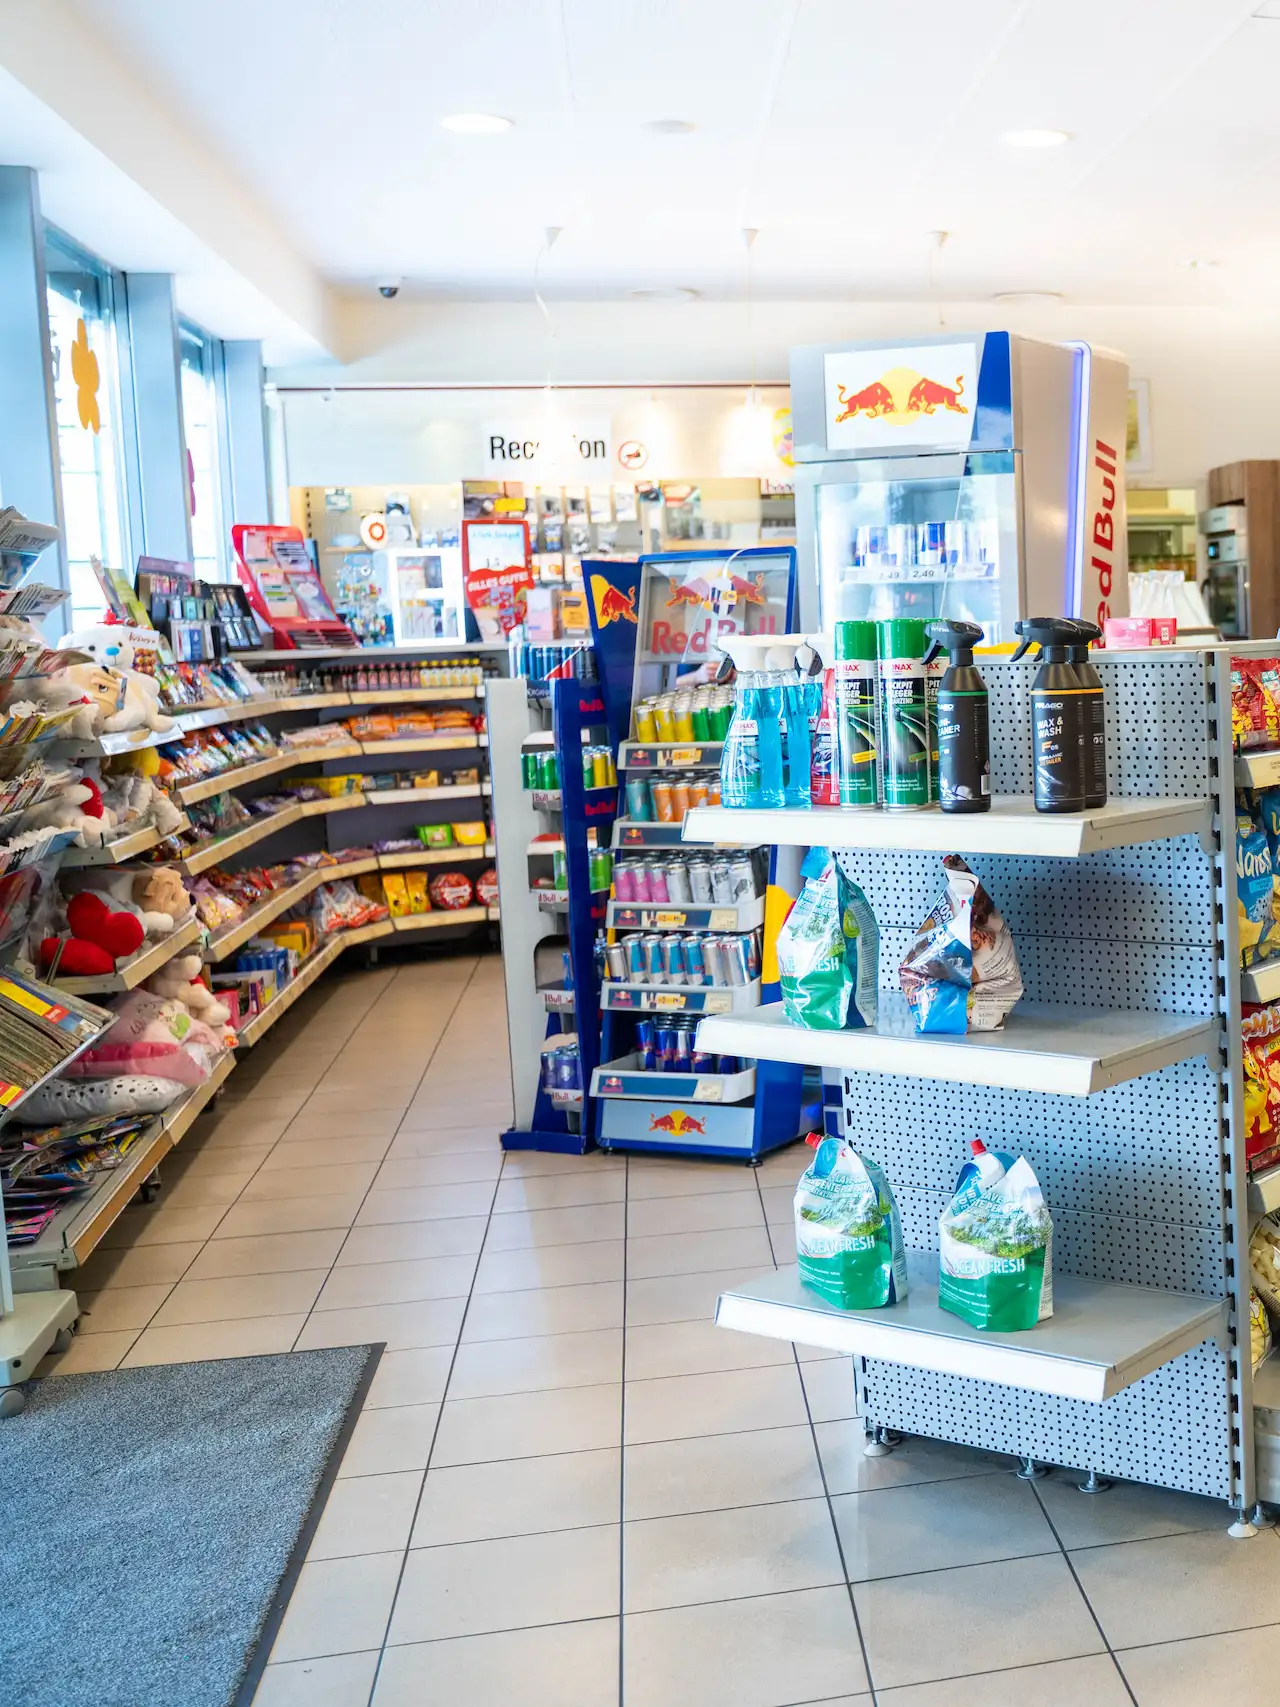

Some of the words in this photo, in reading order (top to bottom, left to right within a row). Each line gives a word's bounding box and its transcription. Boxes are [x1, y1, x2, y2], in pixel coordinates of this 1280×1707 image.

[489, 435, 606, 460] Recon
[1093, 439, 1117, 552] Bull
[1092, 556, 1113, 649] ed
[651, 617, 712, 655] Red
[1036, 717, 1055, 730] WAX
[1056, 715, 1064, 726] &
[1037, 725, 1062, 739] WASH
[840, 1235, 876, 1252] FRESH
[954, 1260, 987, 1275] OCEAN
[988, 1257, 1025, 1273] FRESH
